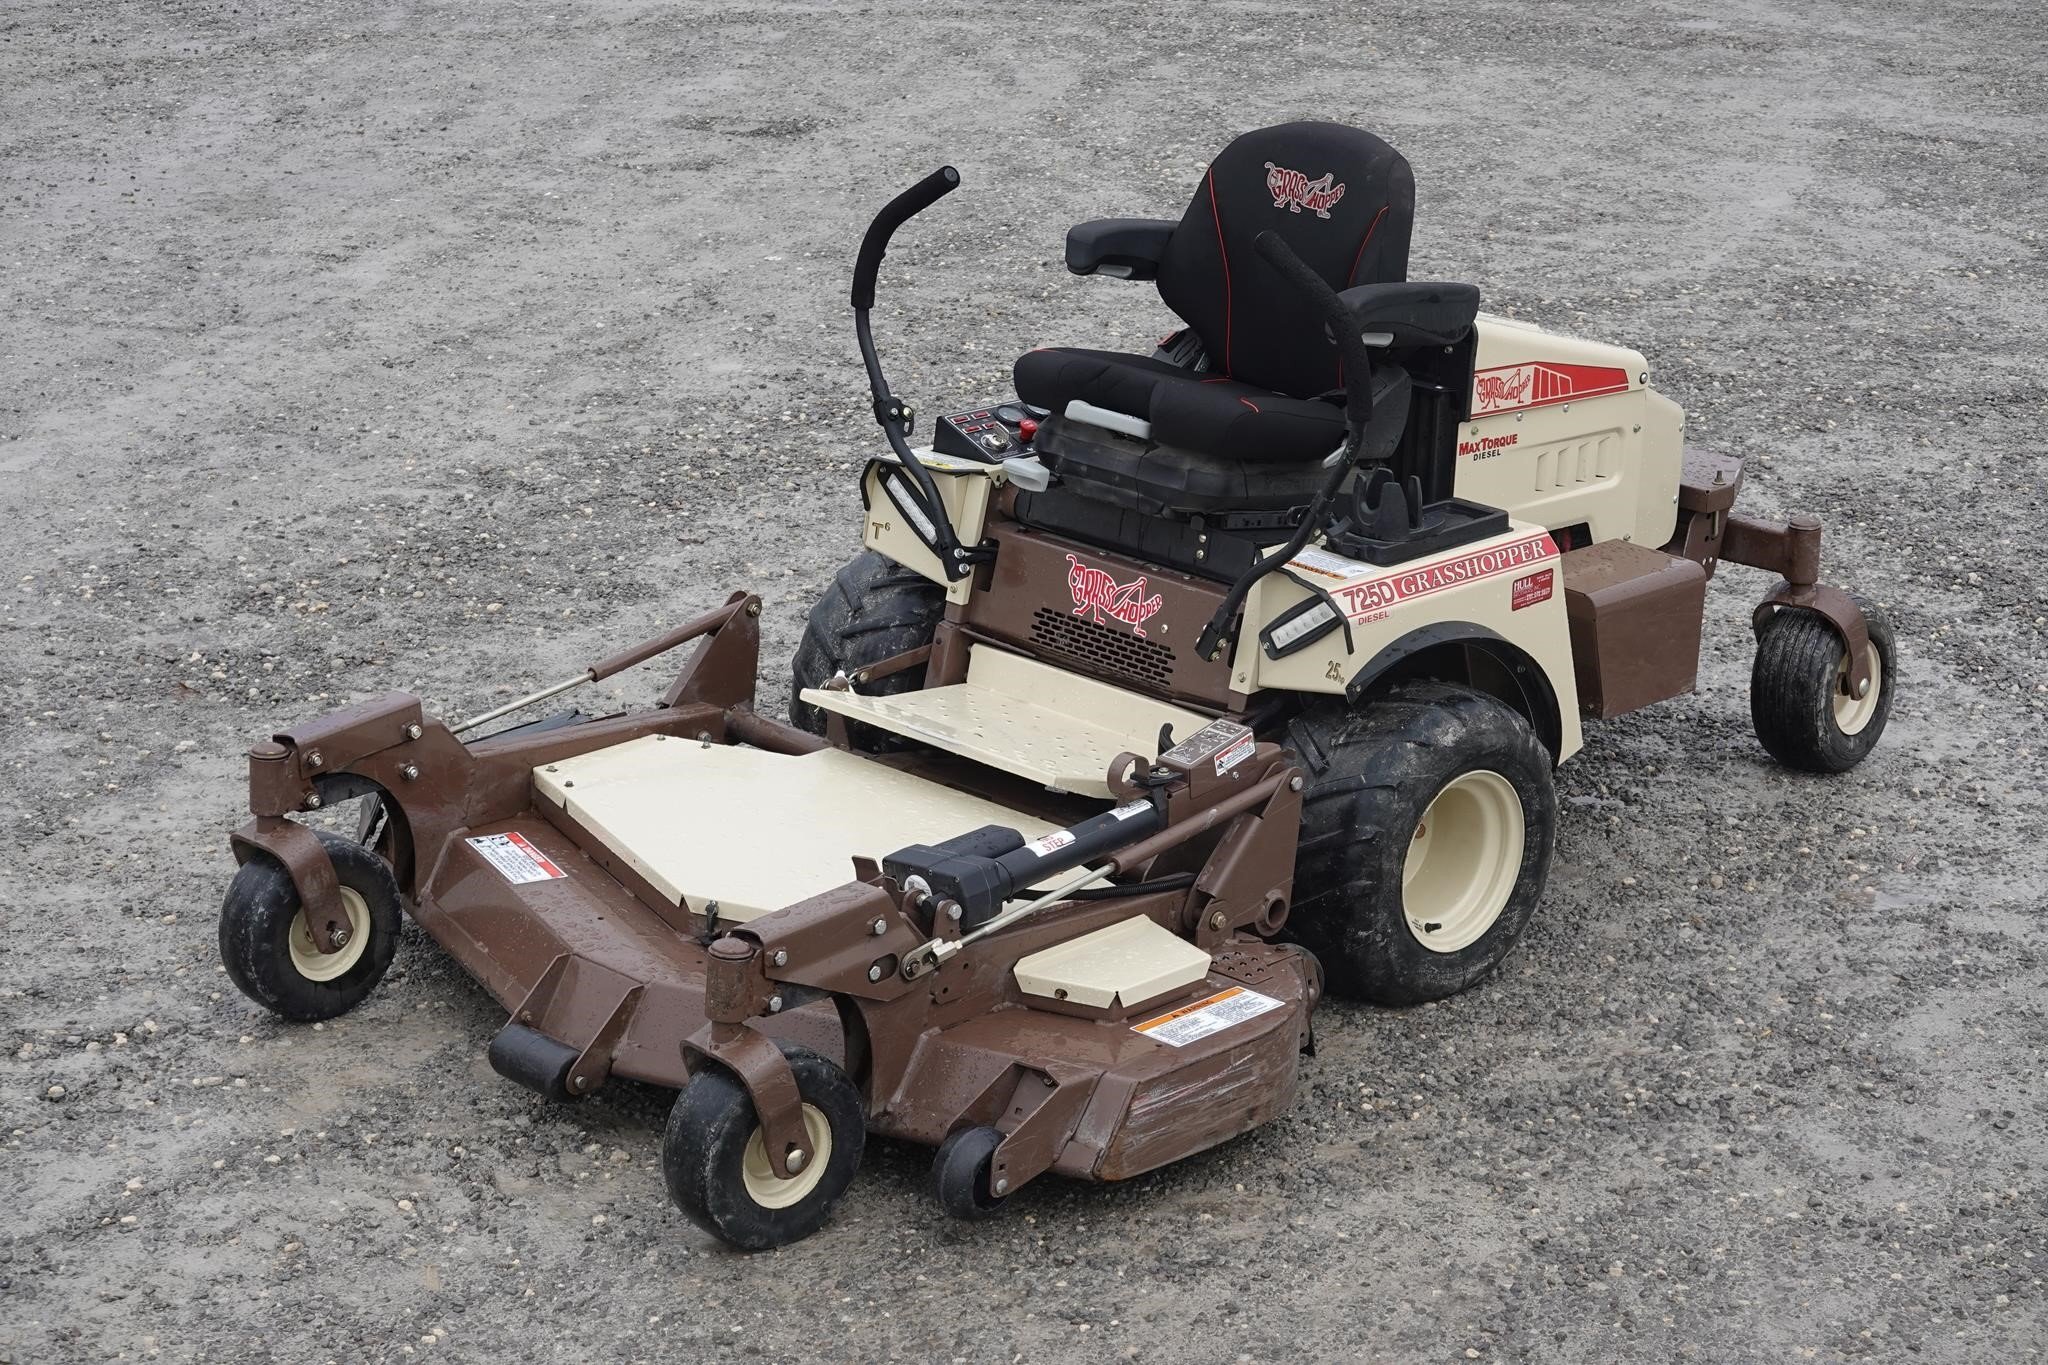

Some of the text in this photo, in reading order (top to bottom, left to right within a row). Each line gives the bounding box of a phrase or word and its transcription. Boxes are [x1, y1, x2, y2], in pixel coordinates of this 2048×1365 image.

[1473, 449, 1502, 461] DIESEL
[1343, 581, 1395, 613] 725D
[1400, 540, 1546, 595] GRASSHOPPER
[1358, 611, 1390, 626] DIESEL
[1042, 837, 1064, 852] STEP
